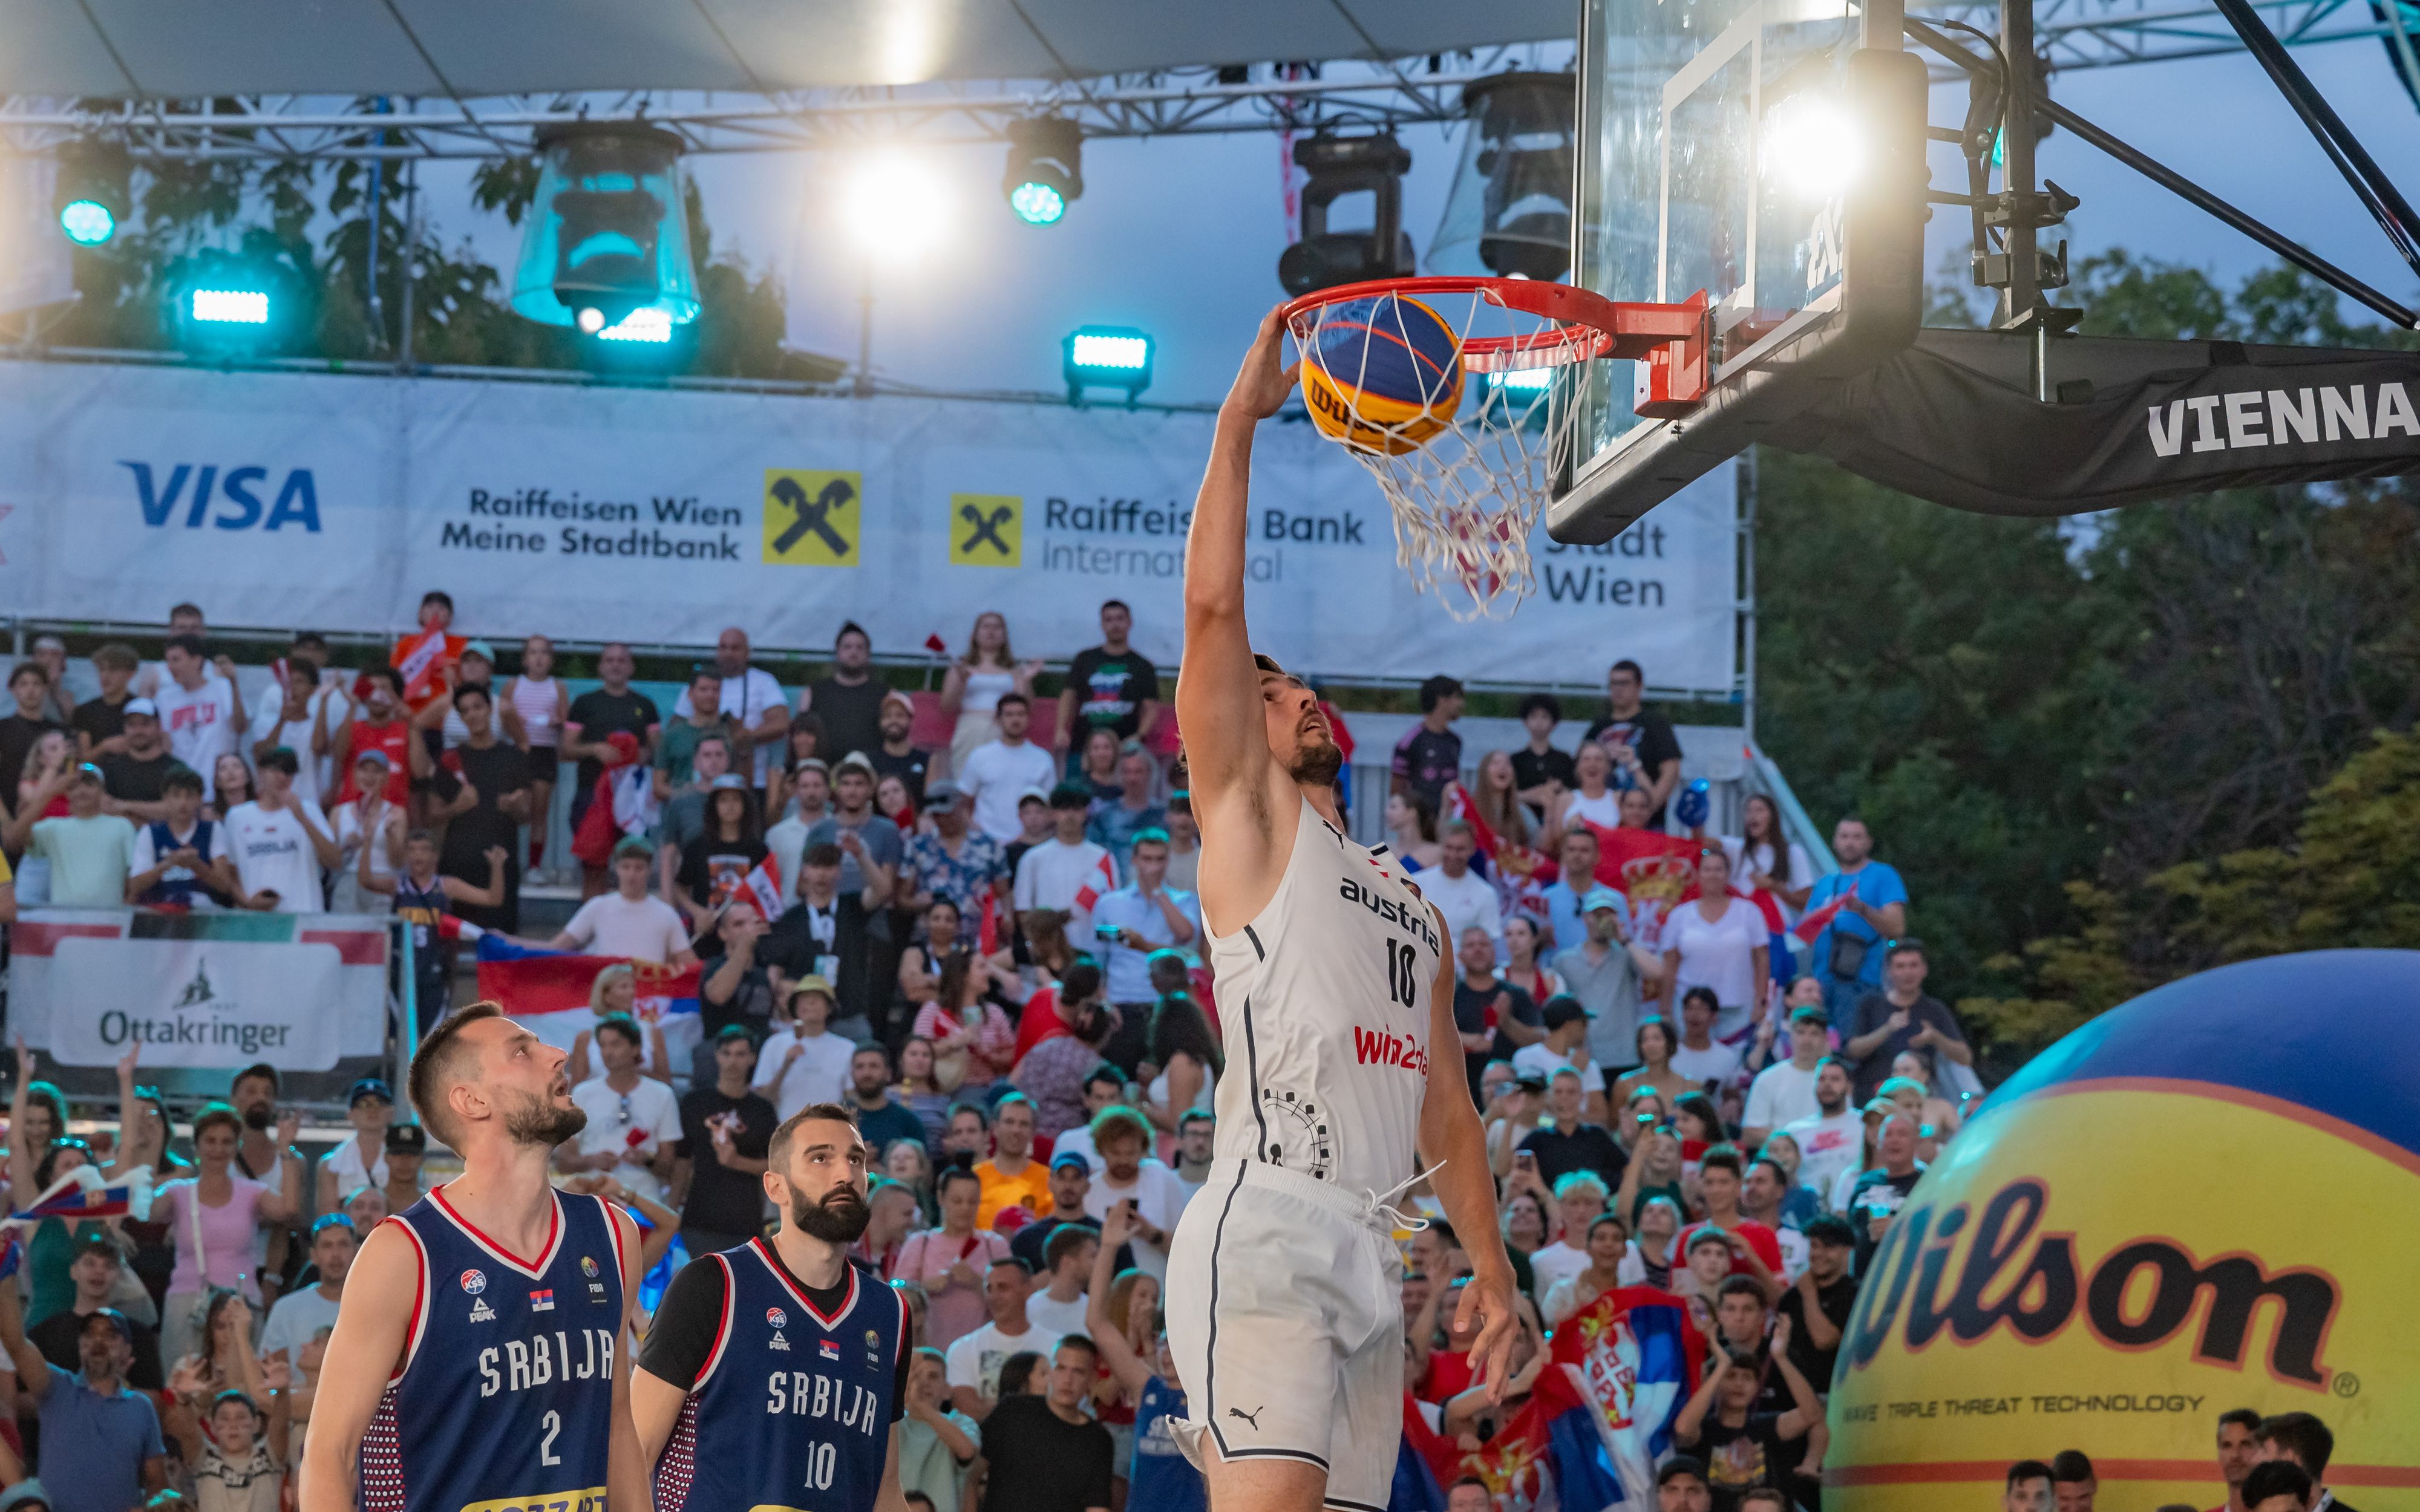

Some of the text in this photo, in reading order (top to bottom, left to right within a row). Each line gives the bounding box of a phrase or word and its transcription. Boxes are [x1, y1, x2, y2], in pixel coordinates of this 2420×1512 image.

[2148, 382, 2420, 457] VIENNA
[115, 460, 322, 533] VISA
[469, 488, 742, 527] Raiffeisen Wien
[1045, 497, 1365, 546] Raiffeis Bank
[440, 521, 740, 561] Meine Stadtbank
[1544, 565, 1664, 607] Wien
[1339, 876, 1440, 957] austria
[1385, 937, 1417, 1009] 10
[99, 1010, 292, 1055] Ottakringer
[1354, 1023, 1428, 1077] win2da
[588, 1283, 604, 1293] FIBA
[469, 1308, 497, 1323] PEAK
[478, 1329, 615, 1398] SRBIJA
[769, 1341, 791, 1352] PEAK
[767, 1370, 877, 1437] SRBIJA
[1887, 1400, 1938, 1418] TRIPLE
[1944, 1396, 2023, 1416] THREAT
[2030, 1393, 2205, 1414] TECHNOLOGY
[541, 1409, 561, 1467] 2
[804, 1439, 837, 1491] 10
